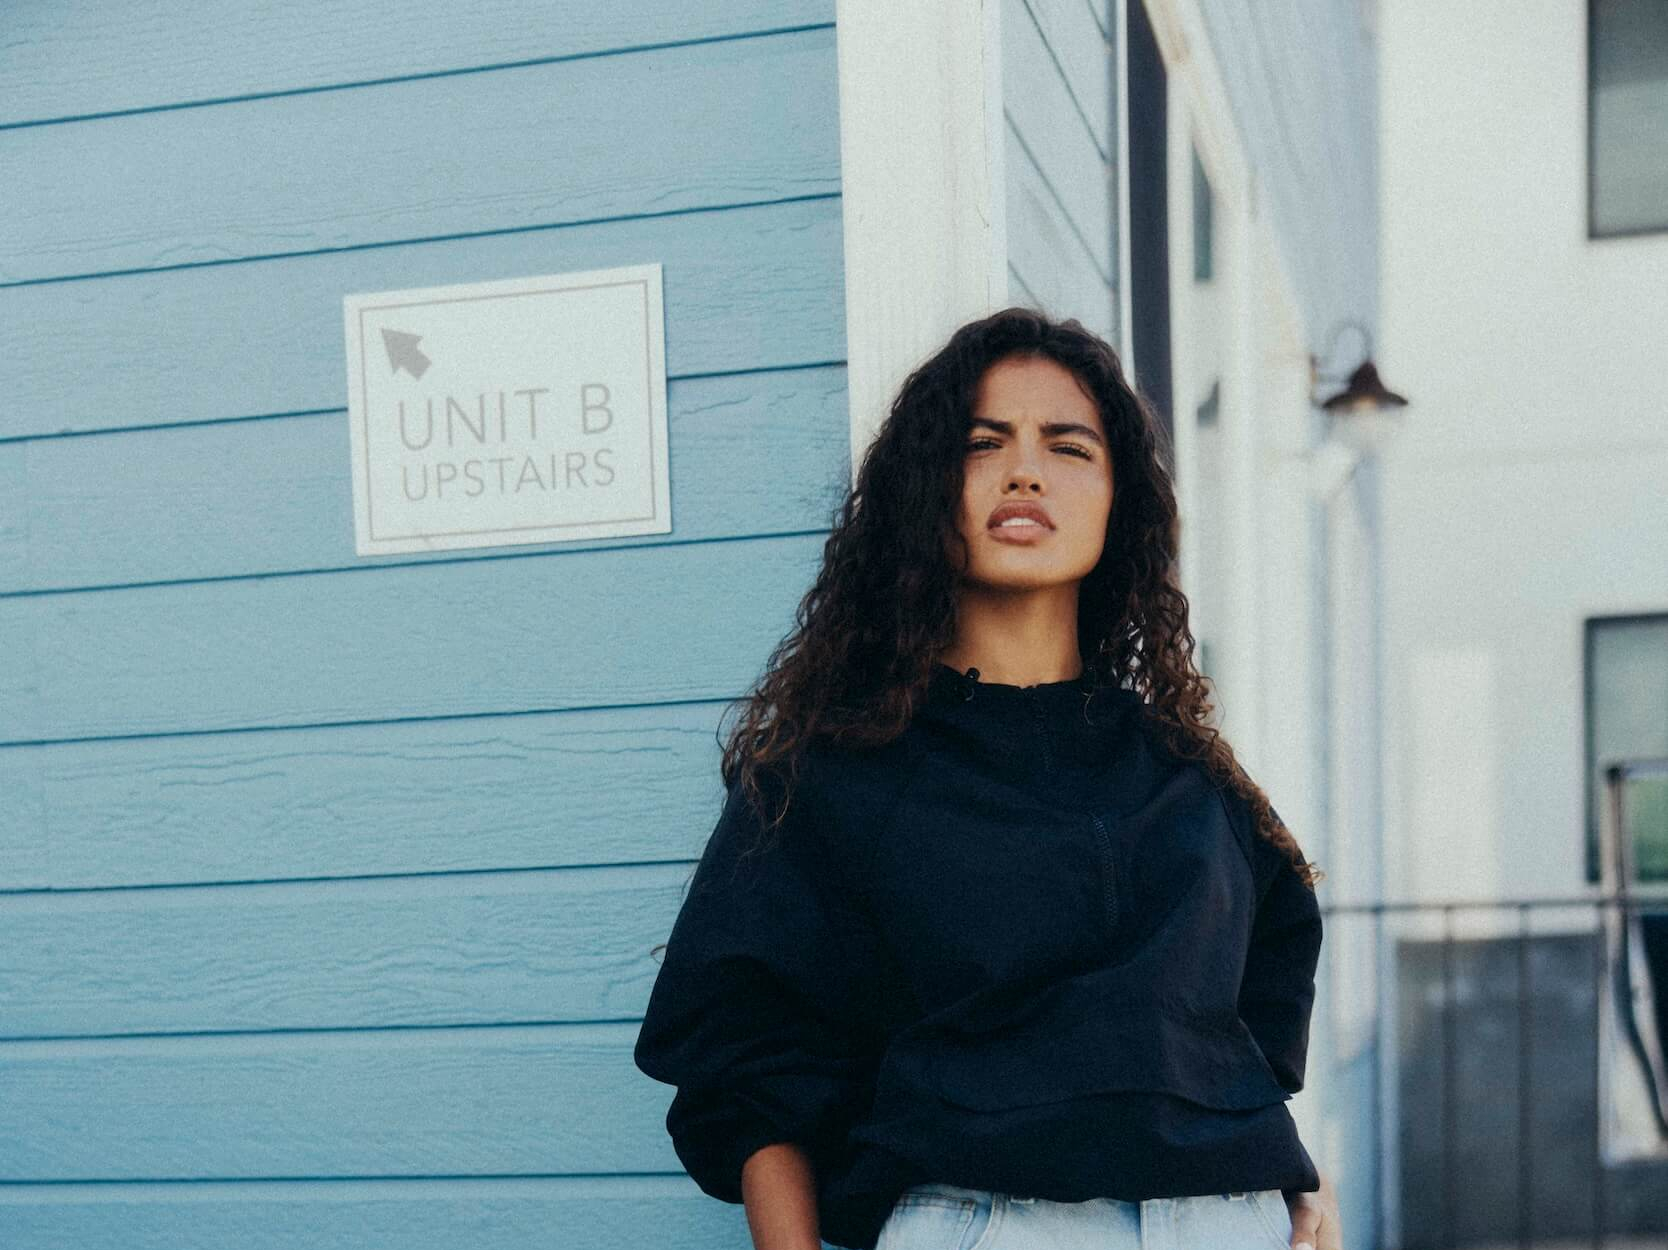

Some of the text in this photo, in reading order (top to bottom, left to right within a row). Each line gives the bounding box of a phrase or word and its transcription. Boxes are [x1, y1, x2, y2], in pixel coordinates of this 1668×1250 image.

[399, 383, 614, 450] UNIT B
[403, 448, 615, 501] UPSTAIRS
